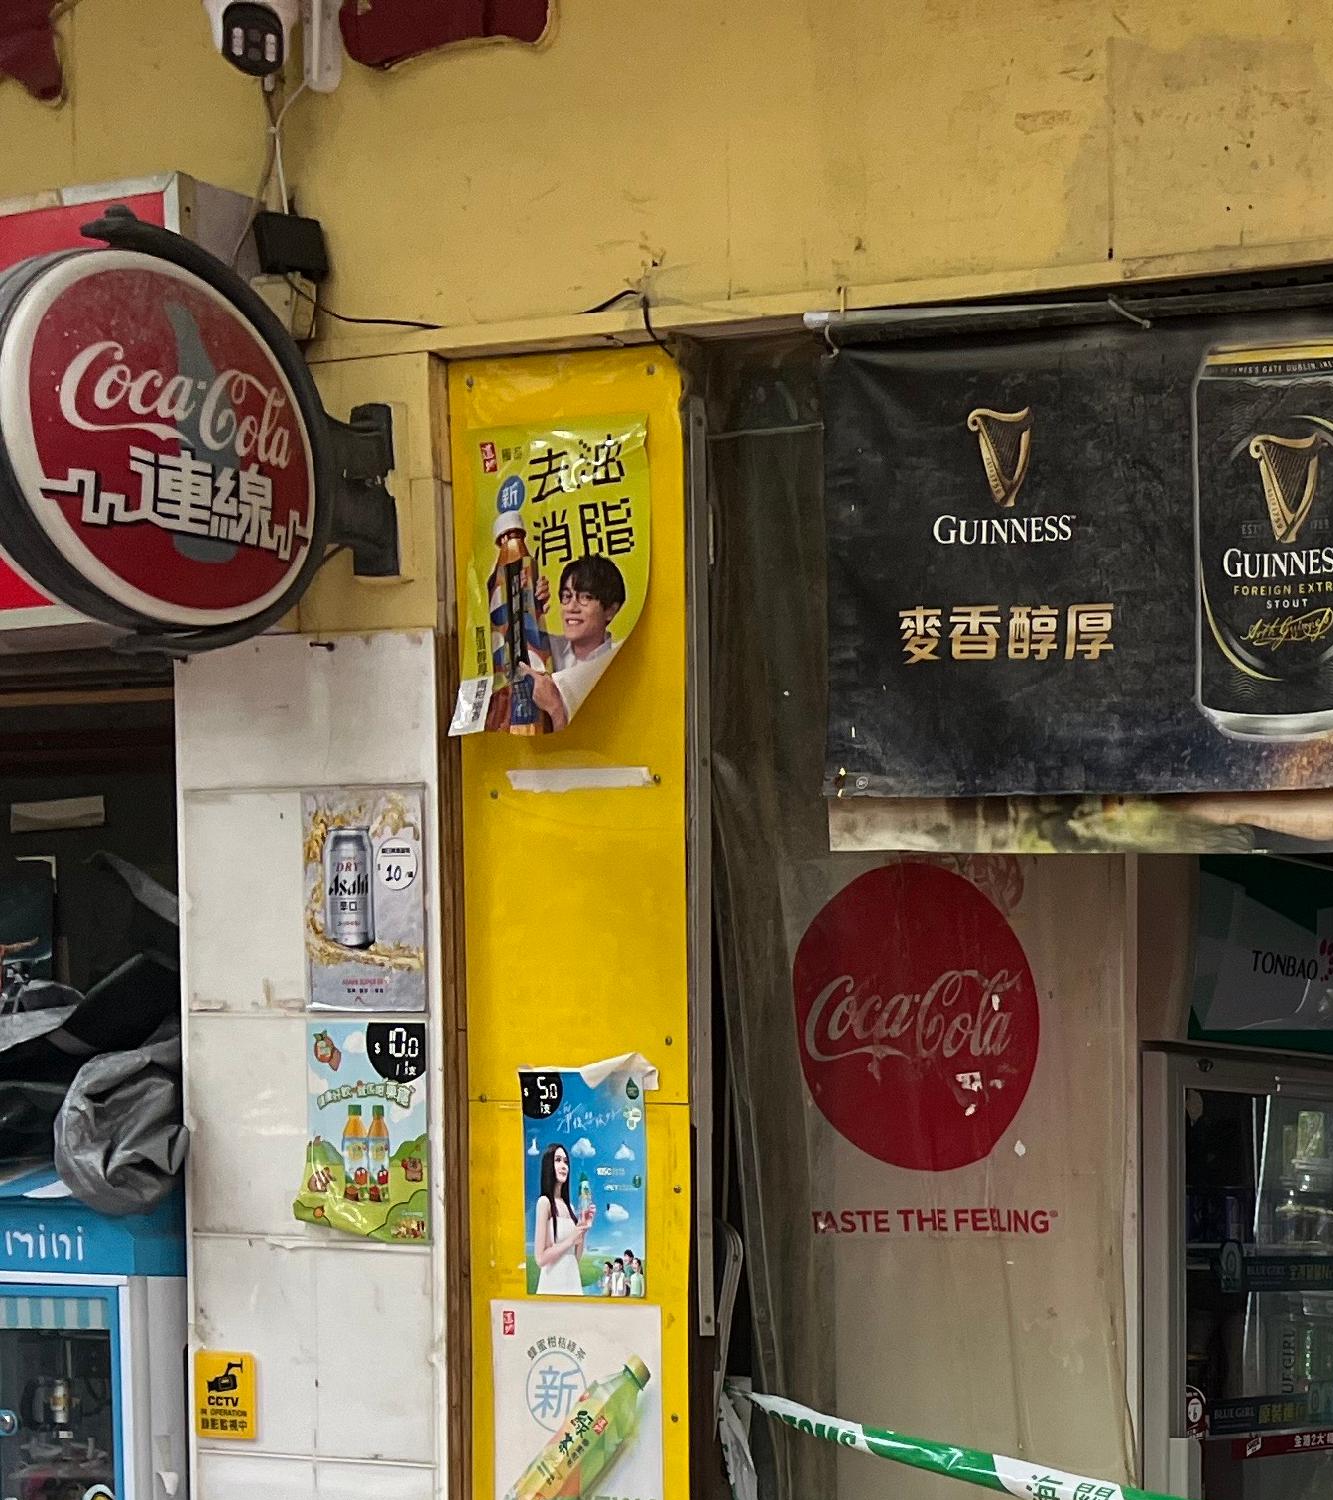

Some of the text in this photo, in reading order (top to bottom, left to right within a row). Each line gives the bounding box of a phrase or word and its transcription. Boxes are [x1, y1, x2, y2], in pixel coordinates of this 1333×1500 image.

[60, 341, 293, 471] Coca-Cola
[129, 445, 275, 546] 連線
[501, 482, 519, 510] 新
[532, 497, 636, 566] 消脂
[932, 514, 1073, 546] GUINNESS
[1233, 583, 1292, 597] FOREIGN
[1265, 598, 1308, 609] STOUT
[898, 602, 1115, 664] 麥香醇厚
[328, 872, 369, 897] Asahi
[1251, 948, 1319, 983] TONBAO
[804, 969, 1023, 1062] Coca-Cola
[374, 1041, 381, 1054] $
[812, 1207, 1051, 1235] TASTE THE FEELING
[5, 1223, 84, 1262] mini
[206, 1395, 240, 1407] CCTV
[531, 1365, 581, 1418] 新
